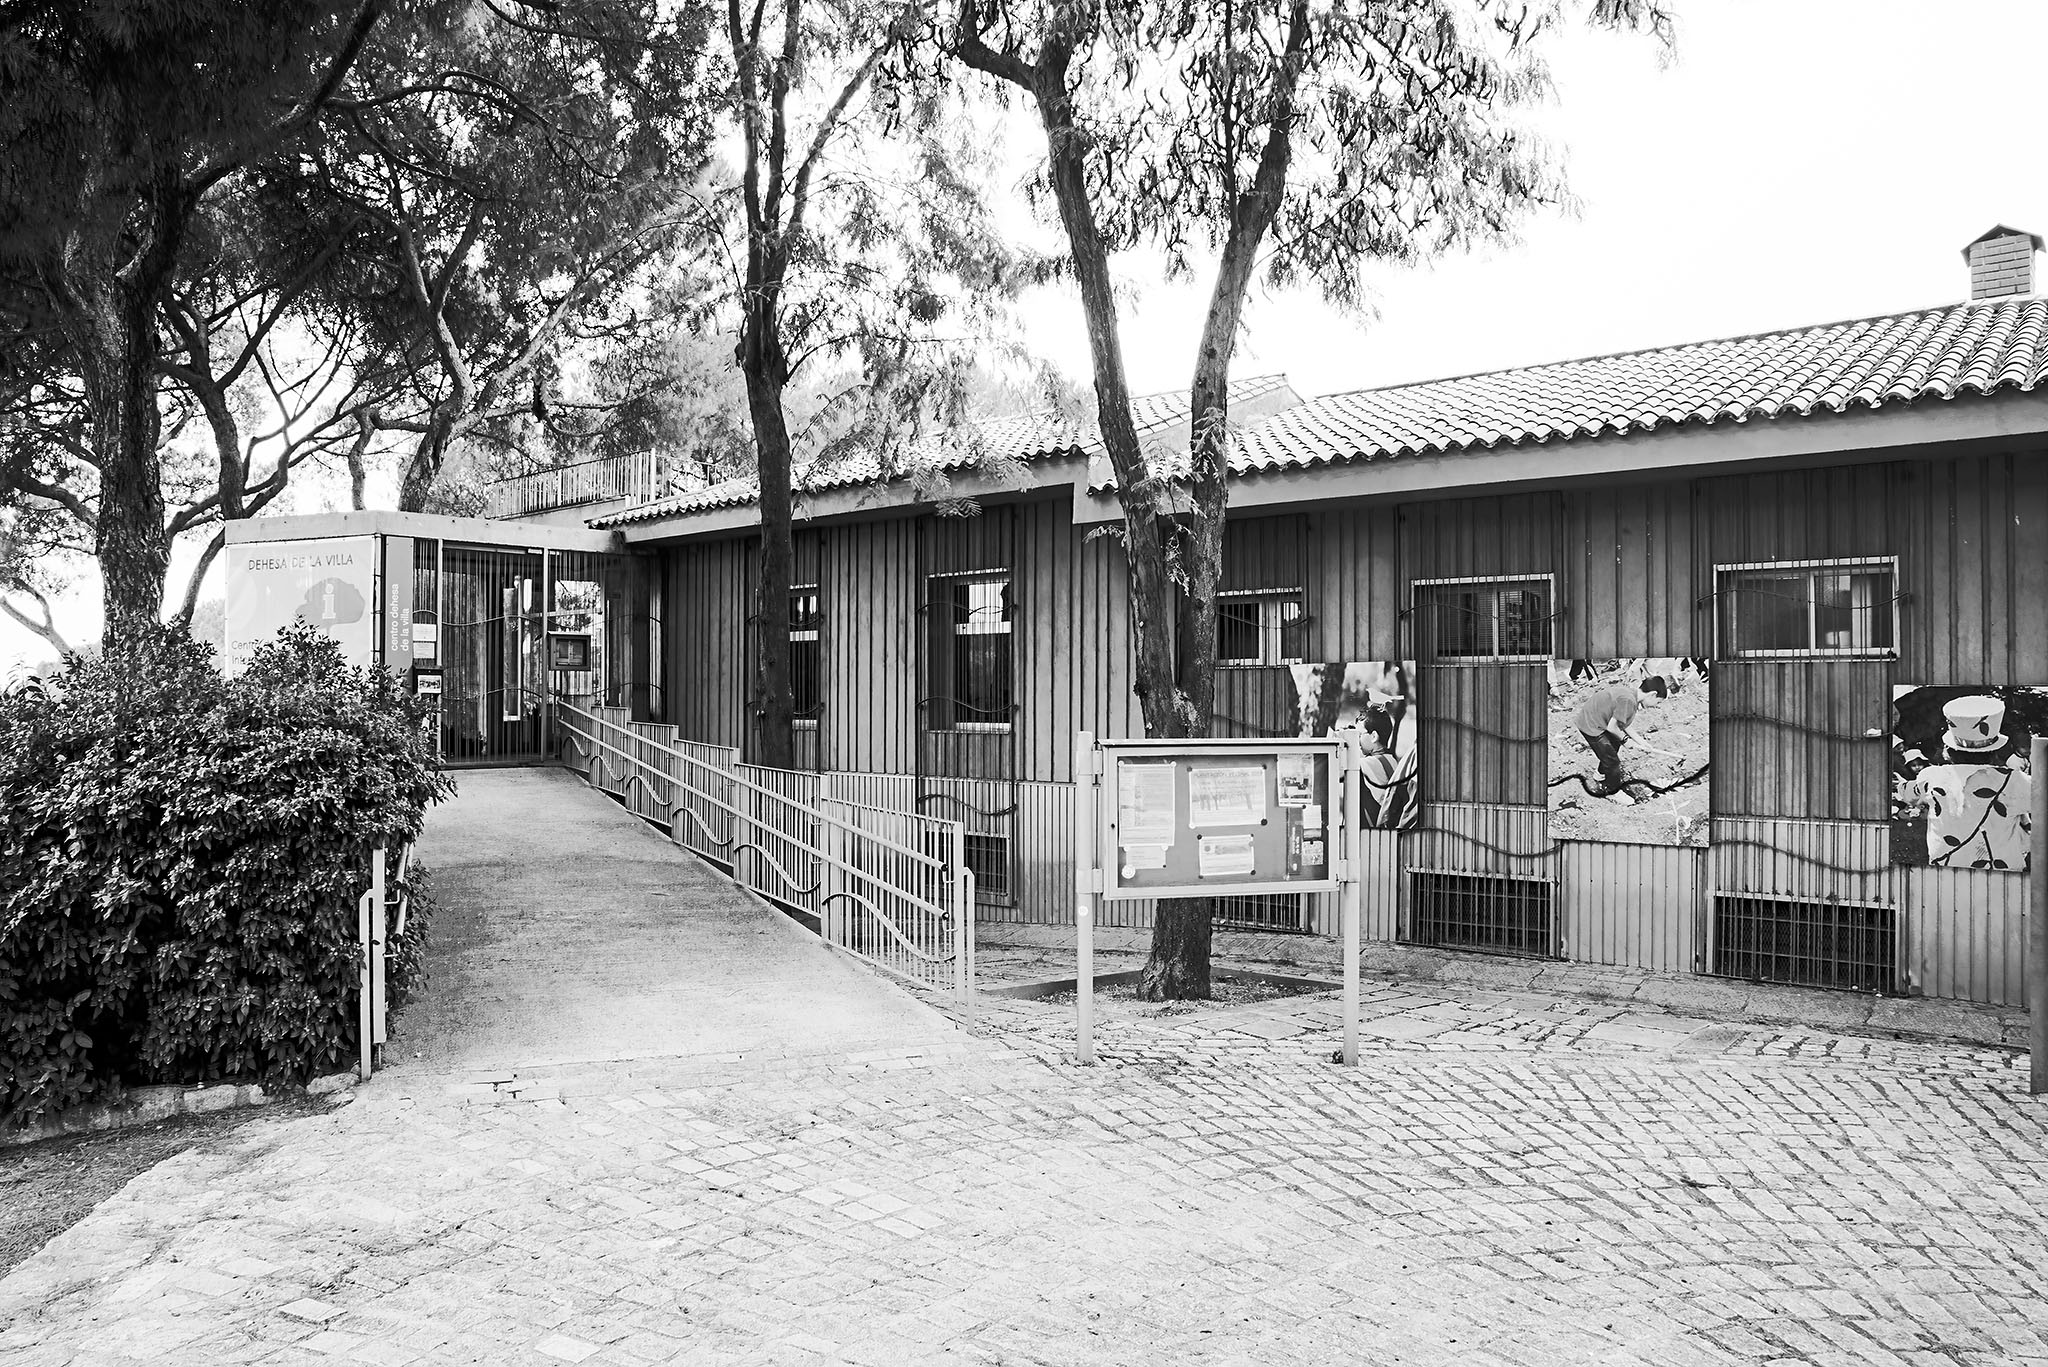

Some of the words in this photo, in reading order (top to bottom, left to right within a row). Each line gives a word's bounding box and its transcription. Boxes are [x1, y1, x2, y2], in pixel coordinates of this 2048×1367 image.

[248, 558, 287, 571] DEHESA
[291, 557, 306, 568] DE
[310, 555, 322, 567] LA
[326, 554, 354, 566] VILLA
[390, 583, 399, 619] dehesa
[400, 608, 410, 626] villa
[390, 620, 399, 652] centro
[400, 628, 409, 637] la
[231, 640, 258, 650] Centr
[400, 639, 409, 652] de
